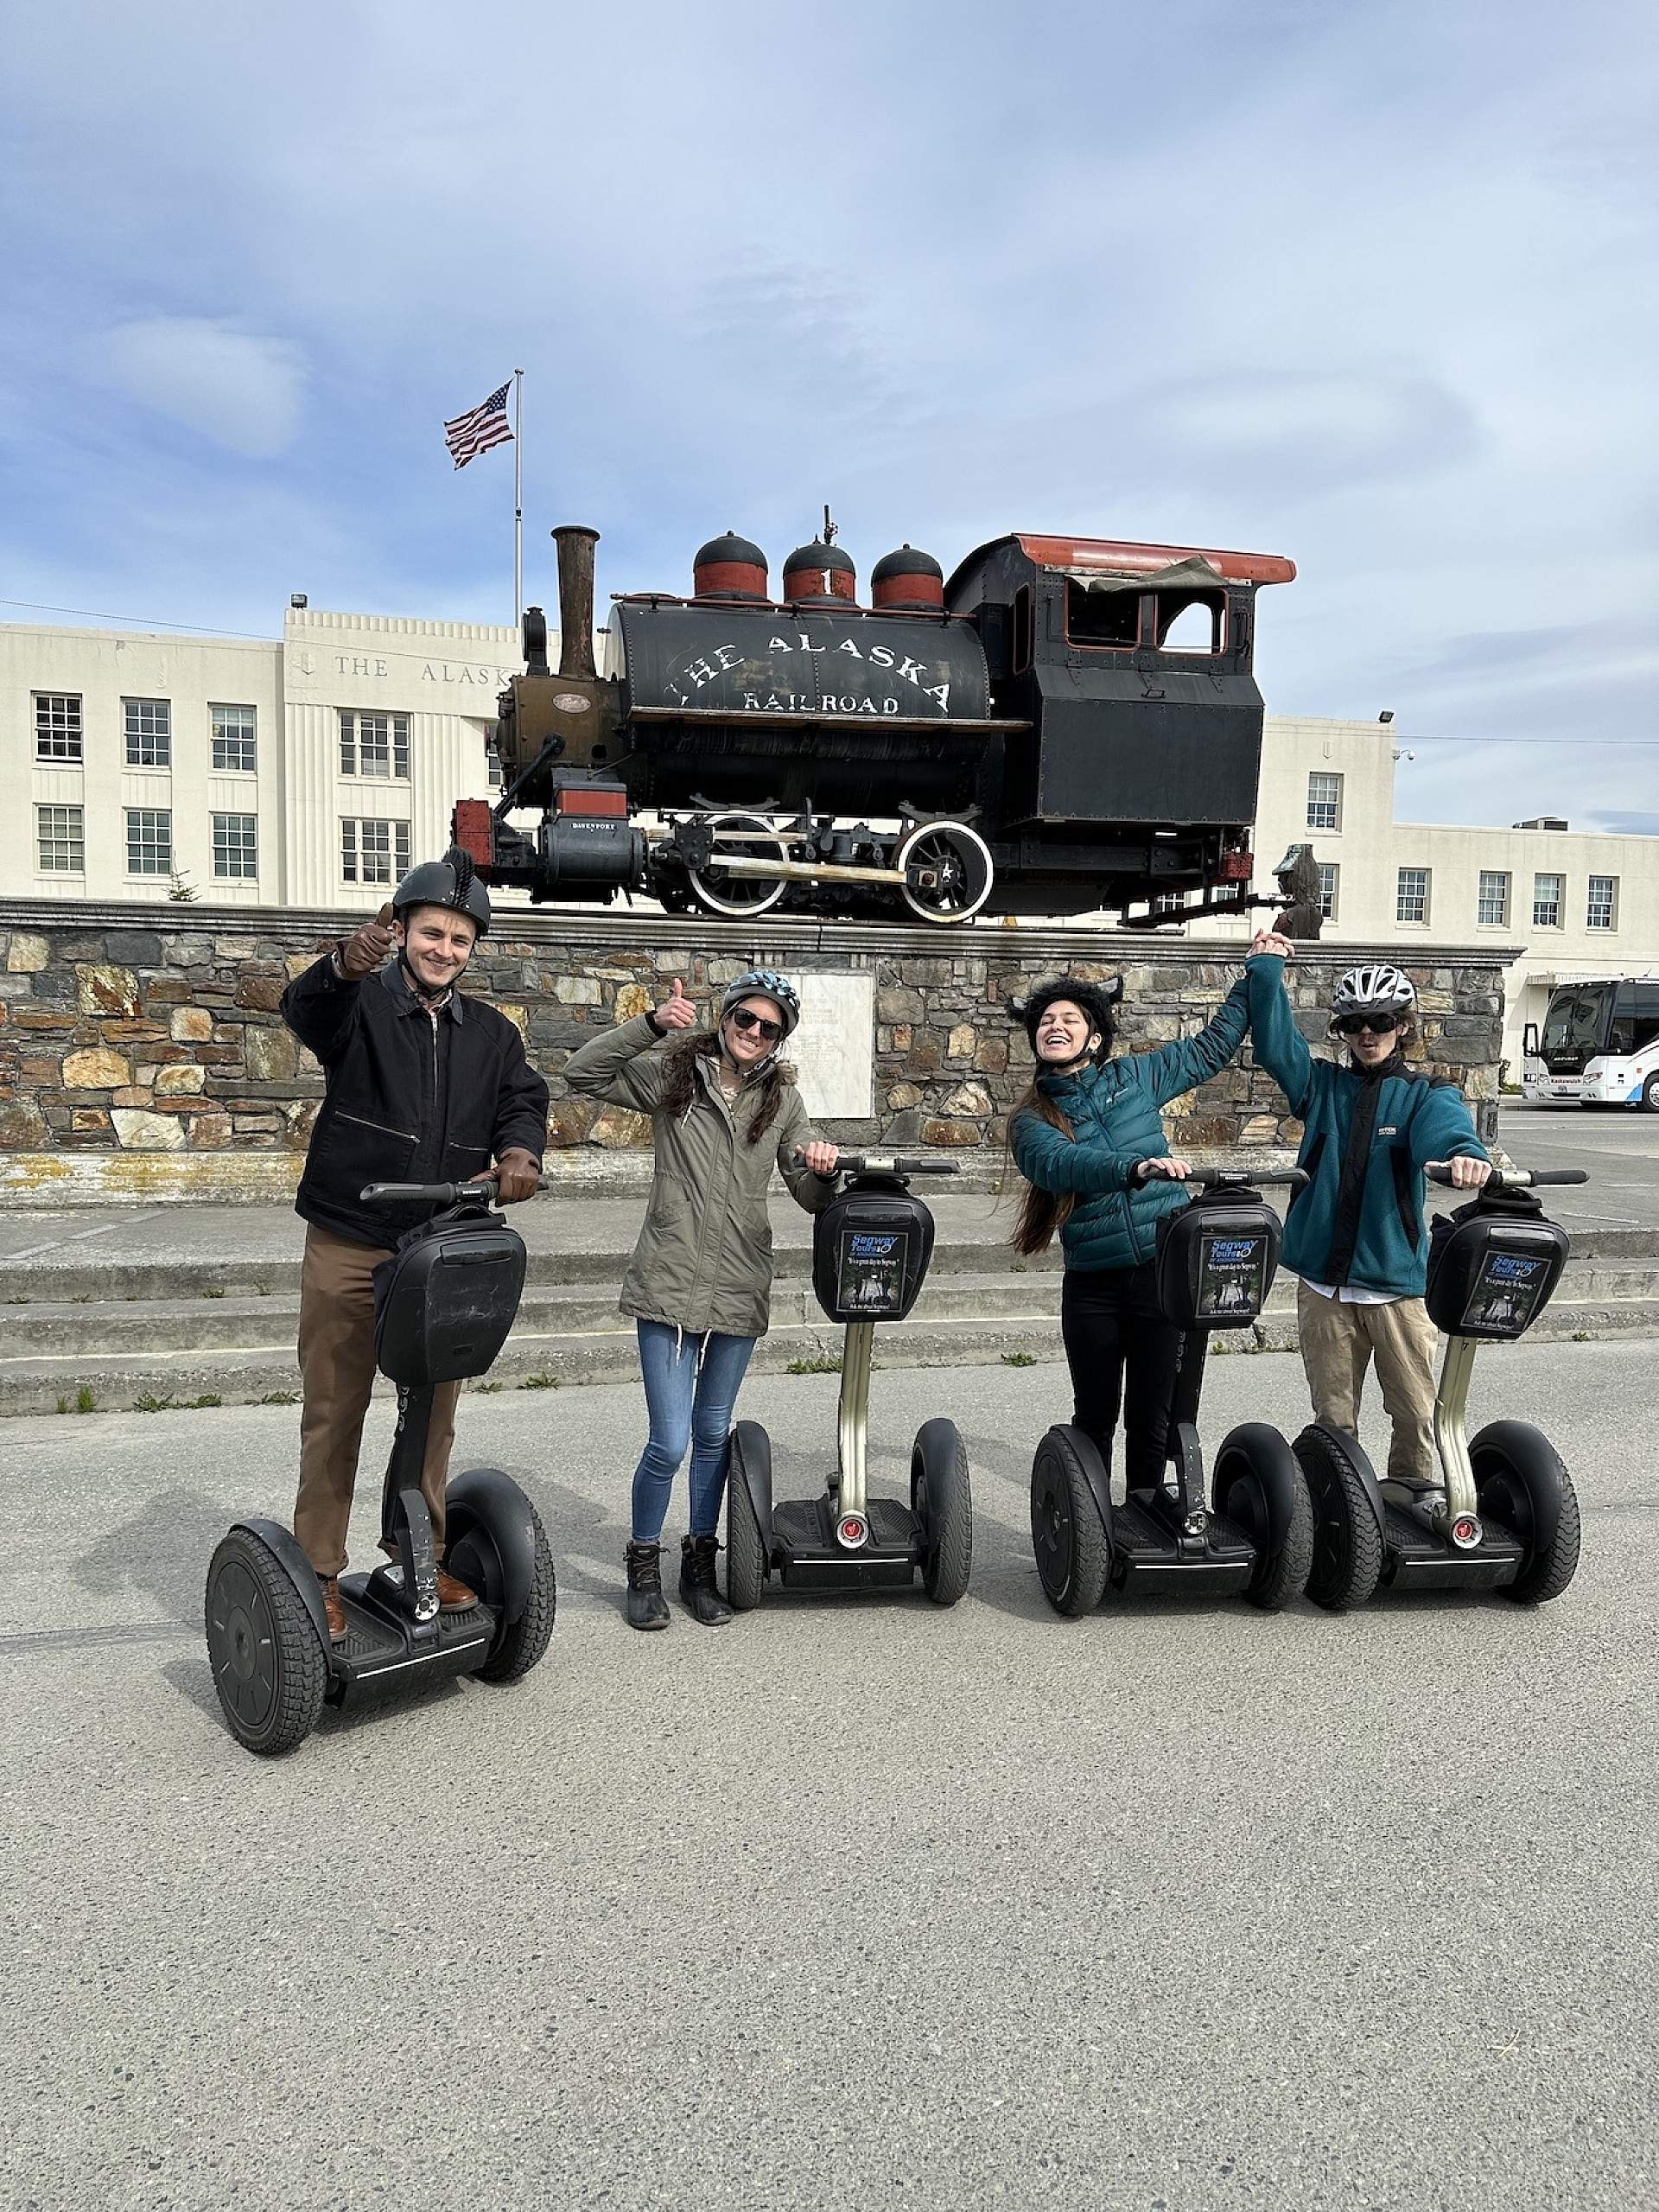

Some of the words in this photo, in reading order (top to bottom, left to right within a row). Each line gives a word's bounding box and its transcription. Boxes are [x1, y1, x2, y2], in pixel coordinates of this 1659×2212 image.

[820, 568, 836, 595] 1
[334, 656, 388, 677] THE
[766, 632, 950, 714] ALASKA
[742, 691, 899, 715] RAILROAD
[852, 1233, 899, 1247] Segway
[1212, 1239, 1258, 1250] Segway
[850, 1243, 877, 1253] Tours
[1211, 1248, 1236, 1258] Tours
[1491, 1263, 1517, 1275] Tours
[1493, 1255, 1542, 1270] Segway
